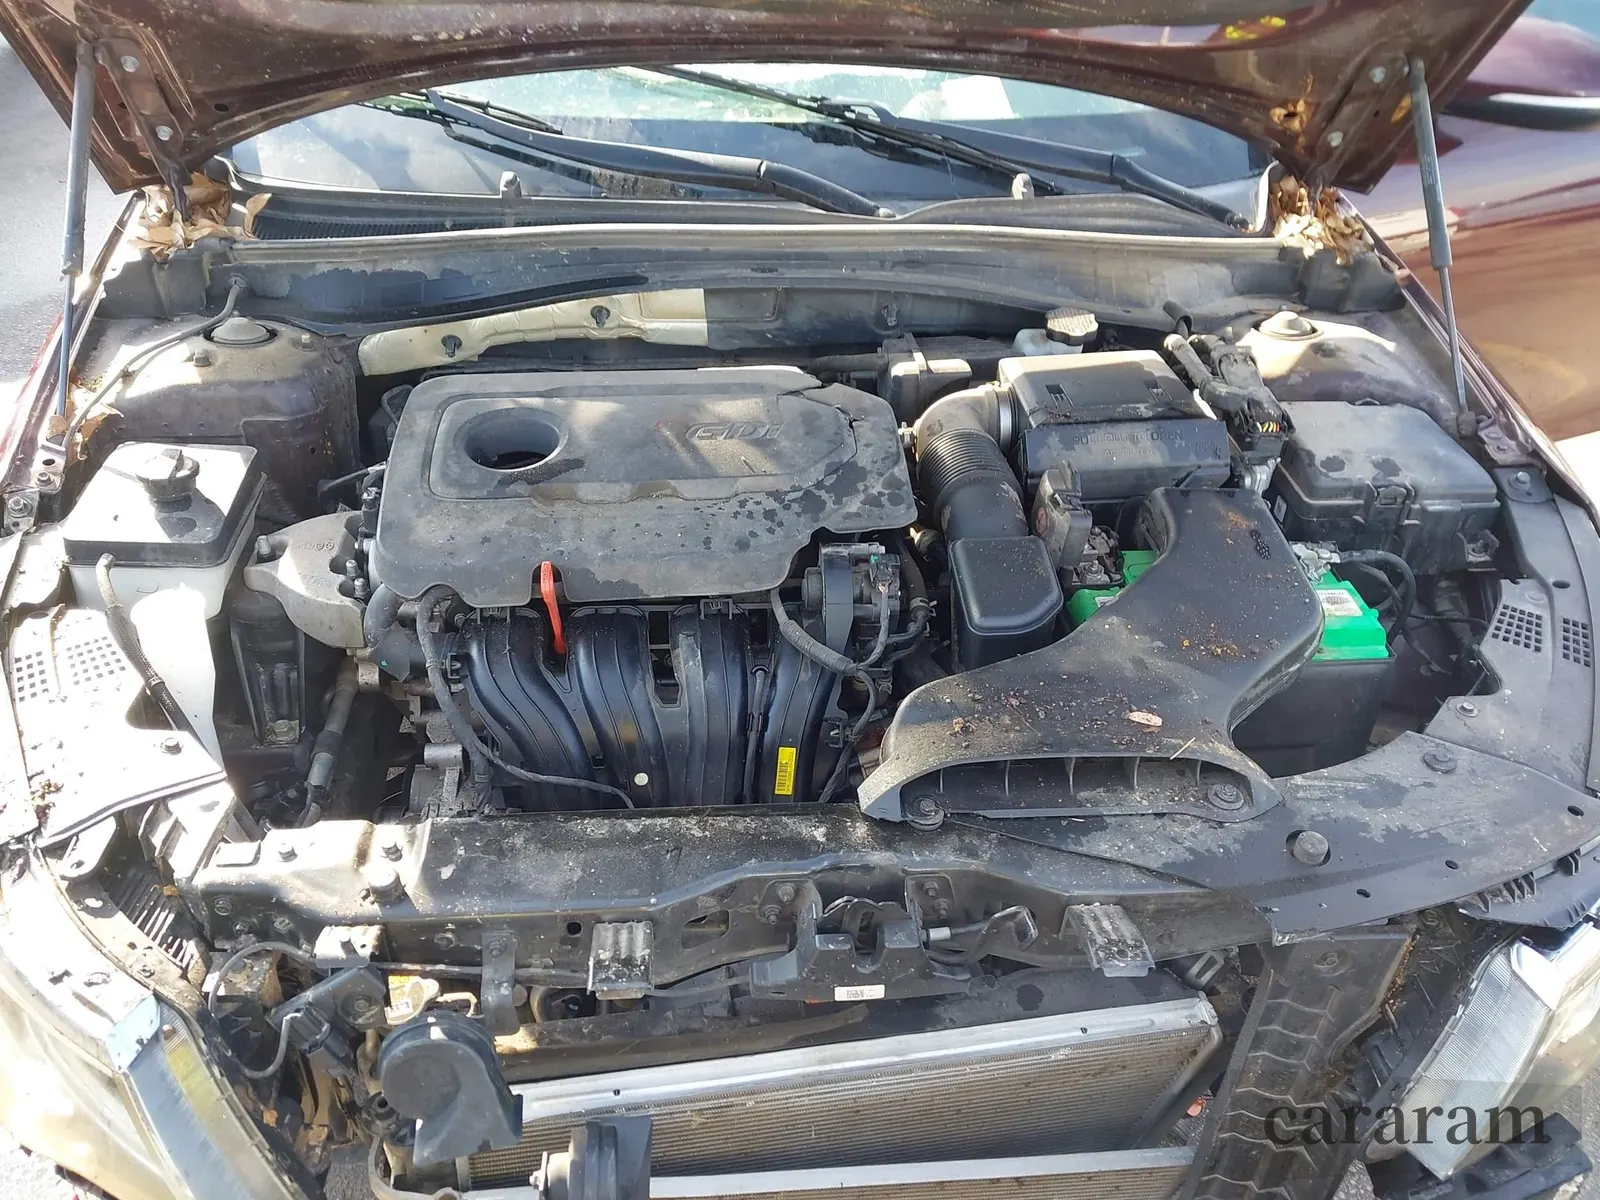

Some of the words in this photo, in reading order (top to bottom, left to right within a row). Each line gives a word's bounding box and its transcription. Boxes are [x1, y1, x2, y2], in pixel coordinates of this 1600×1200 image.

[1072, 433, 1101, 445] PULL
[1103, 432, 1129, 444] OUT
[1131, 431, 1148, 443] TO
[1150, 429, 1184, 442] OPEN
